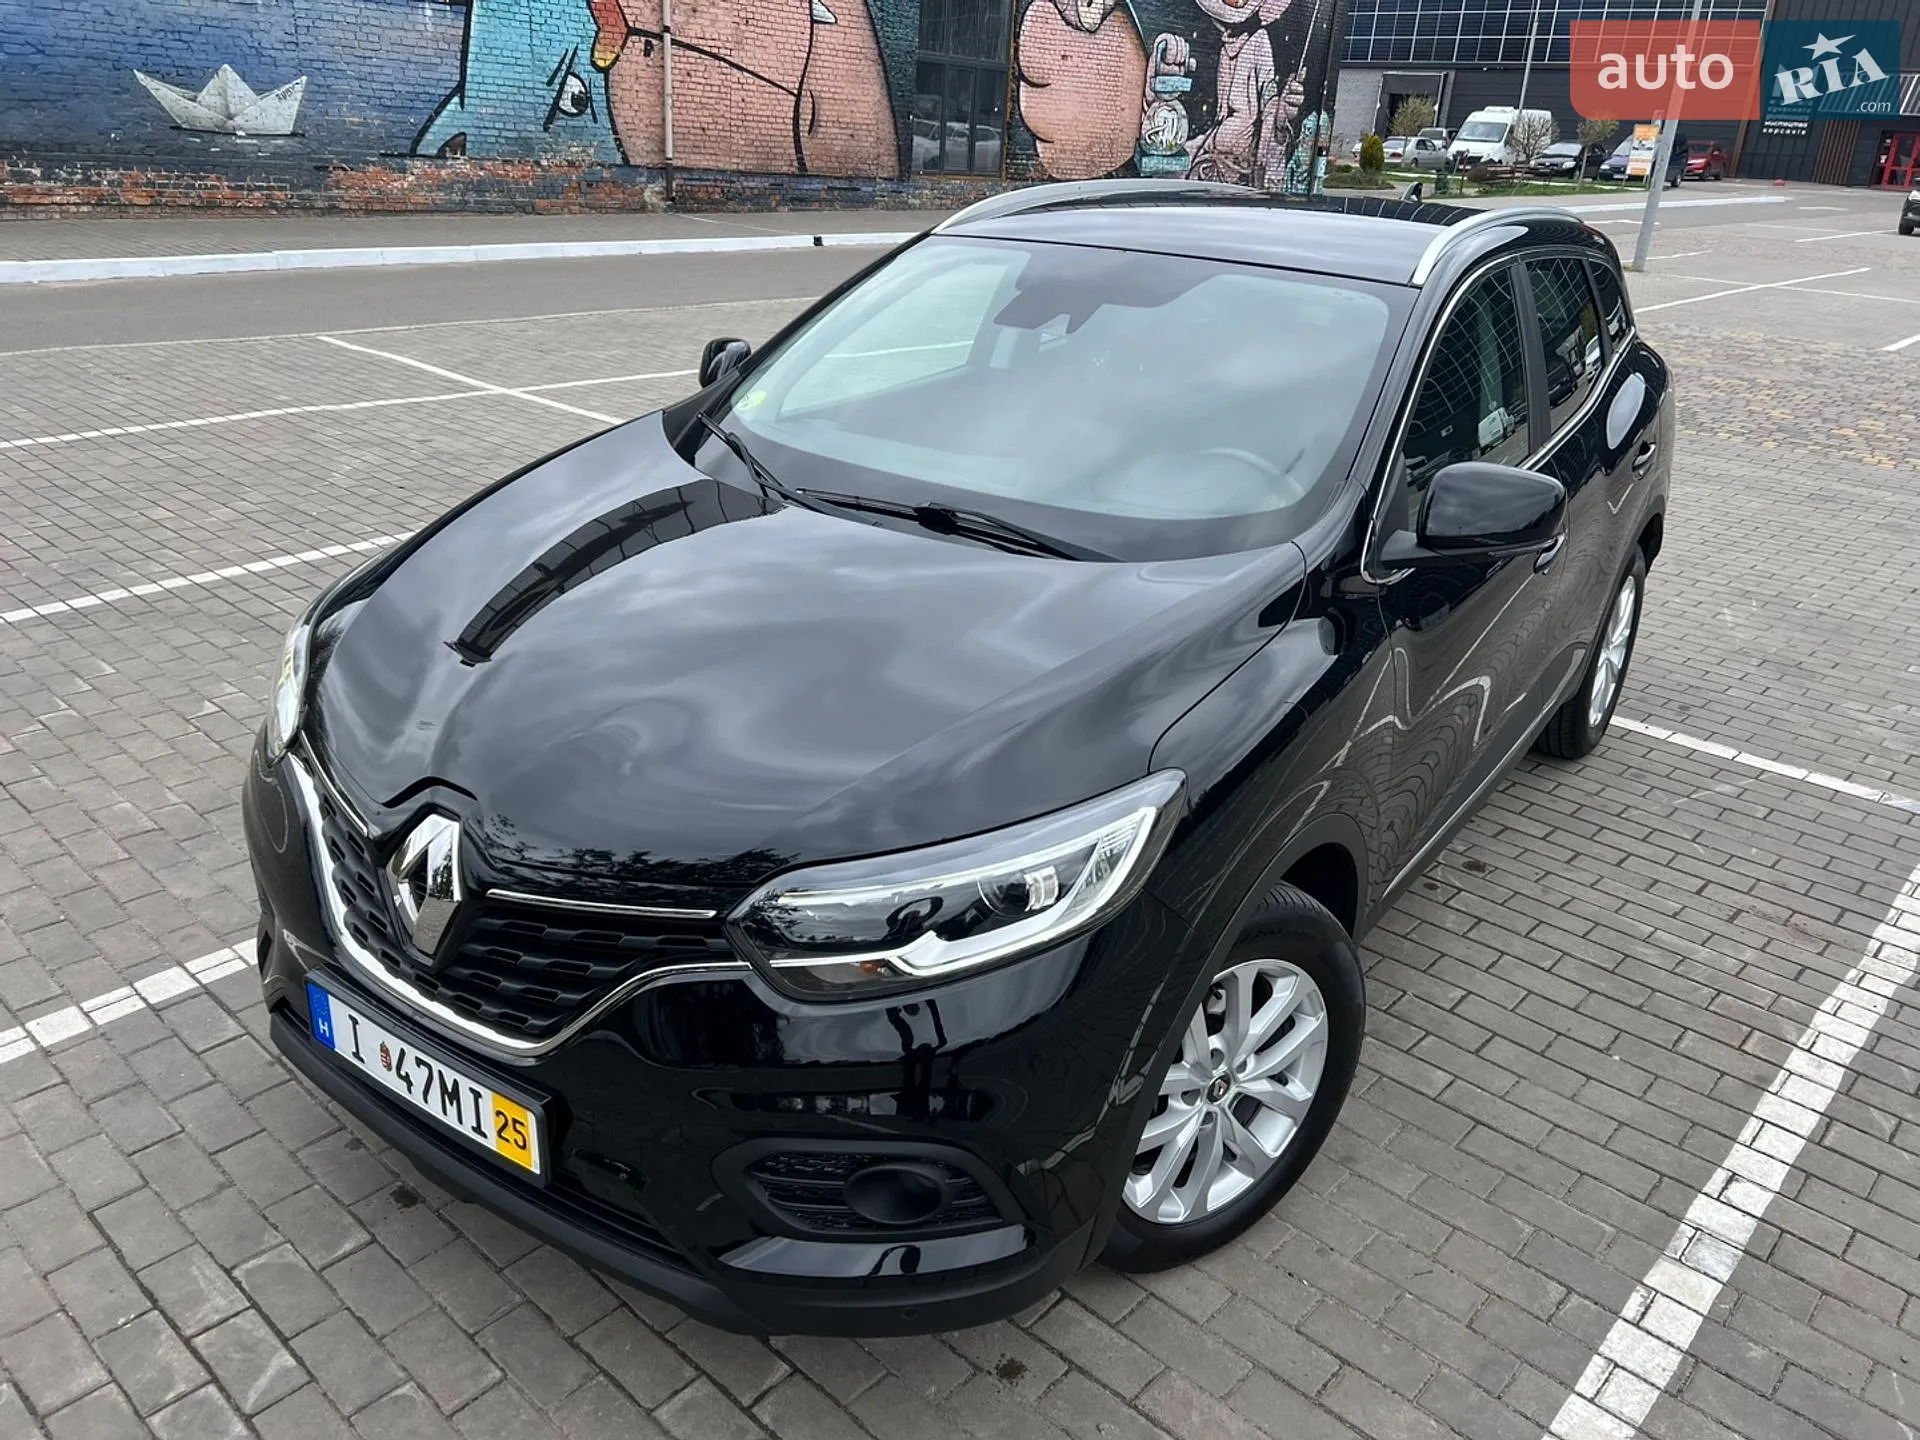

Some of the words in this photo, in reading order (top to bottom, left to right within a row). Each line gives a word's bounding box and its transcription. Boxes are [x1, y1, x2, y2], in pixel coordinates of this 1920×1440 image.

[318, 1017, 330, 1038] H
[395, 1047, 489, 1140] 47MI
[495, 1109, 528, 1151] 25
